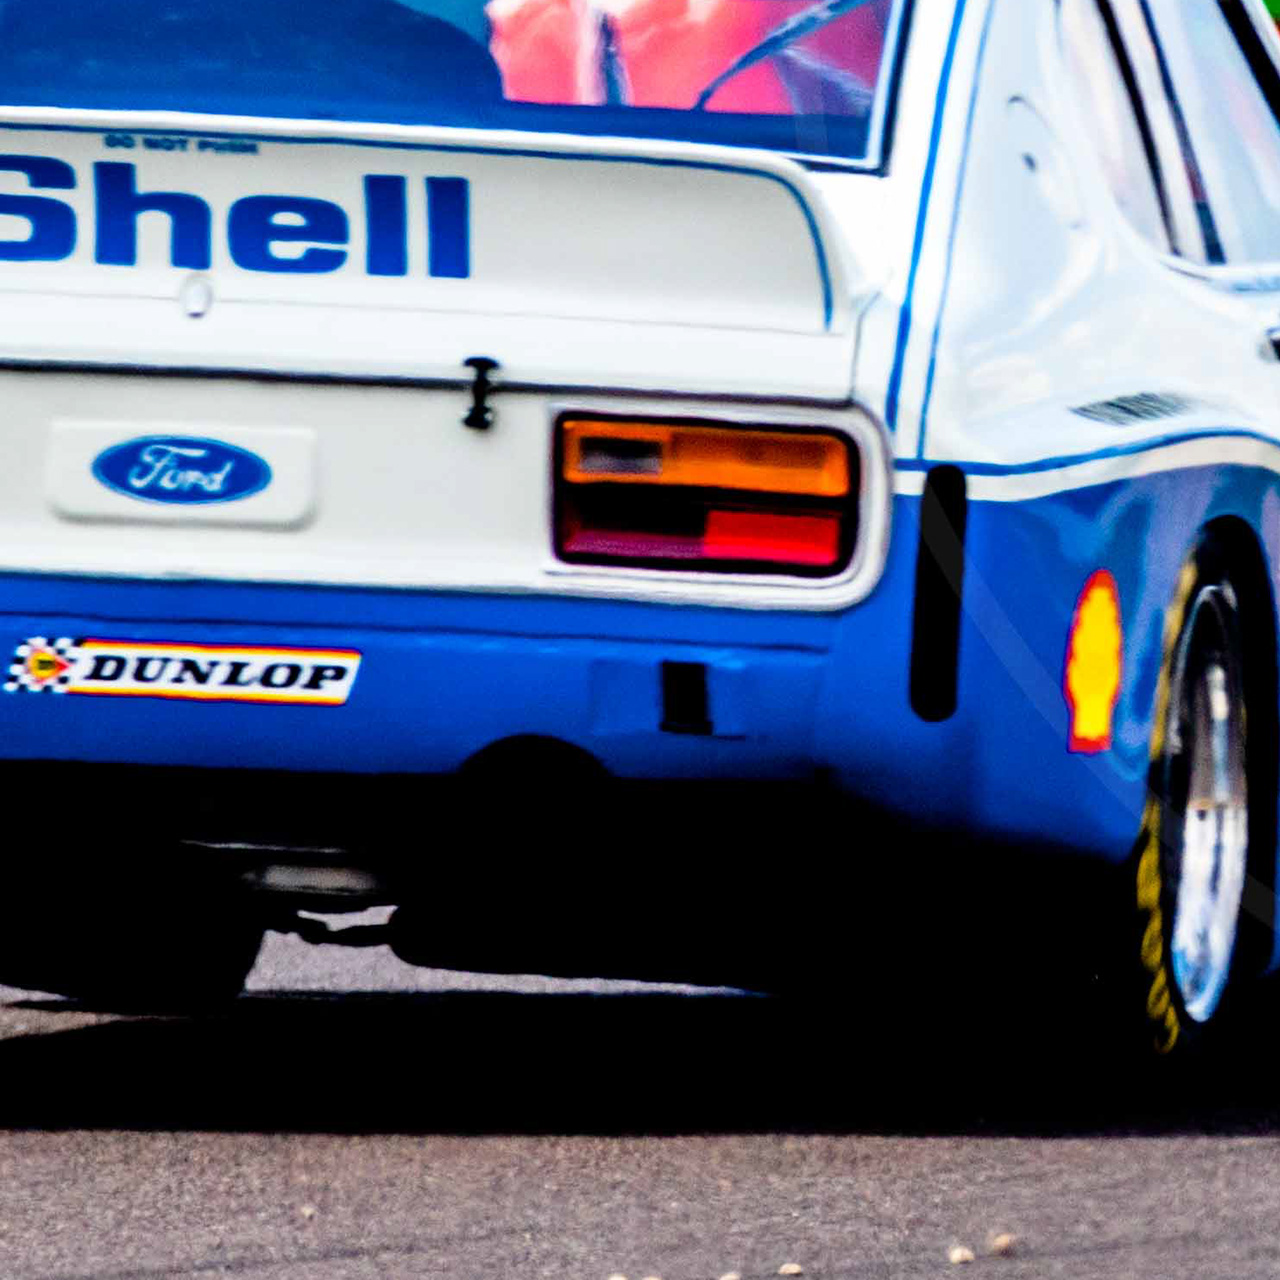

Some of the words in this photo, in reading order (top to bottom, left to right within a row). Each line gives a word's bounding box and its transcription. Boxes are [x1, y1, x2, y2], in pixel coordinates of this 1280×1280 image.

[0, 154, 470, 280] Shell
[128, 444, 233, 496] Ford
[84, 653, 348, 691] DUNLOP
